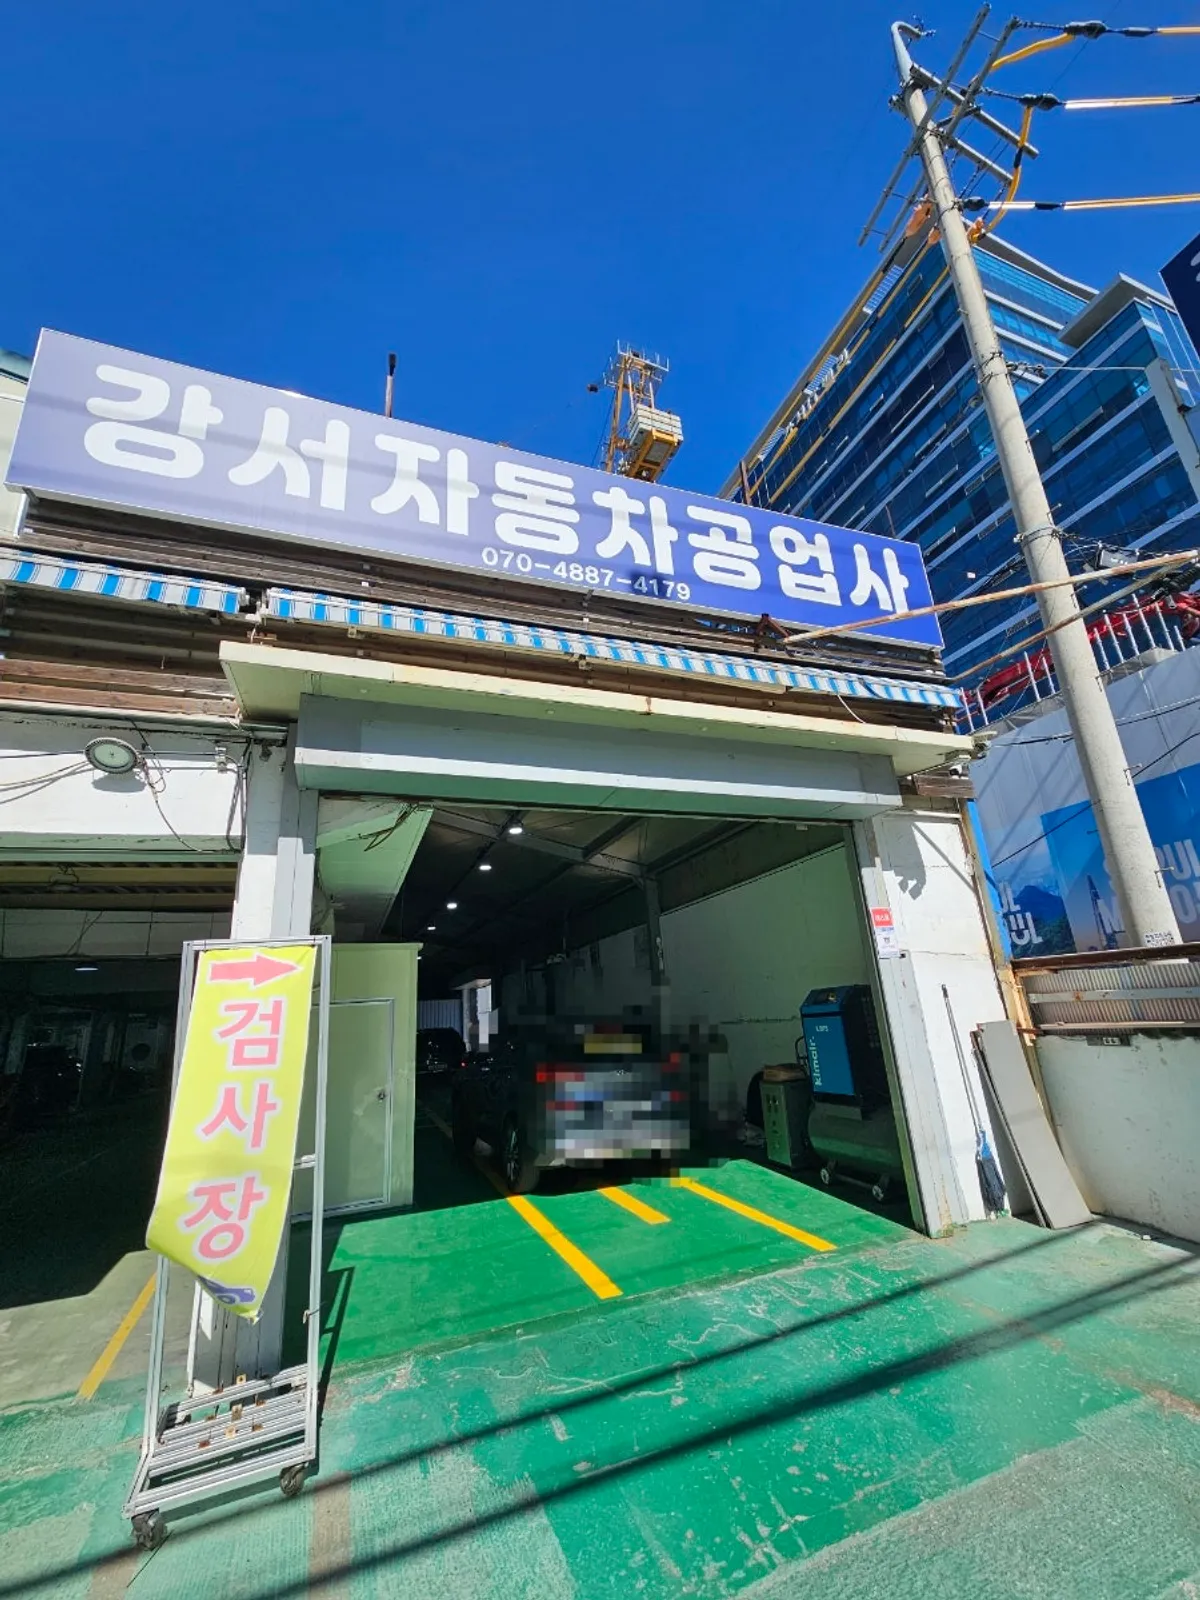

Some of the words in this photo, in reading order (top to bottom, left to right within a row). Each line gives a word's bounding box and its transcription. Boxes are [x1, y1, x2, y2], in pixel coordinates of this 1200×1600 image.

[84, 364, 909, 613] 강서자동차공업사
[481, 547, 691, 601] 070-4887-4179
[184, 998, 284, 1260] 검사장
